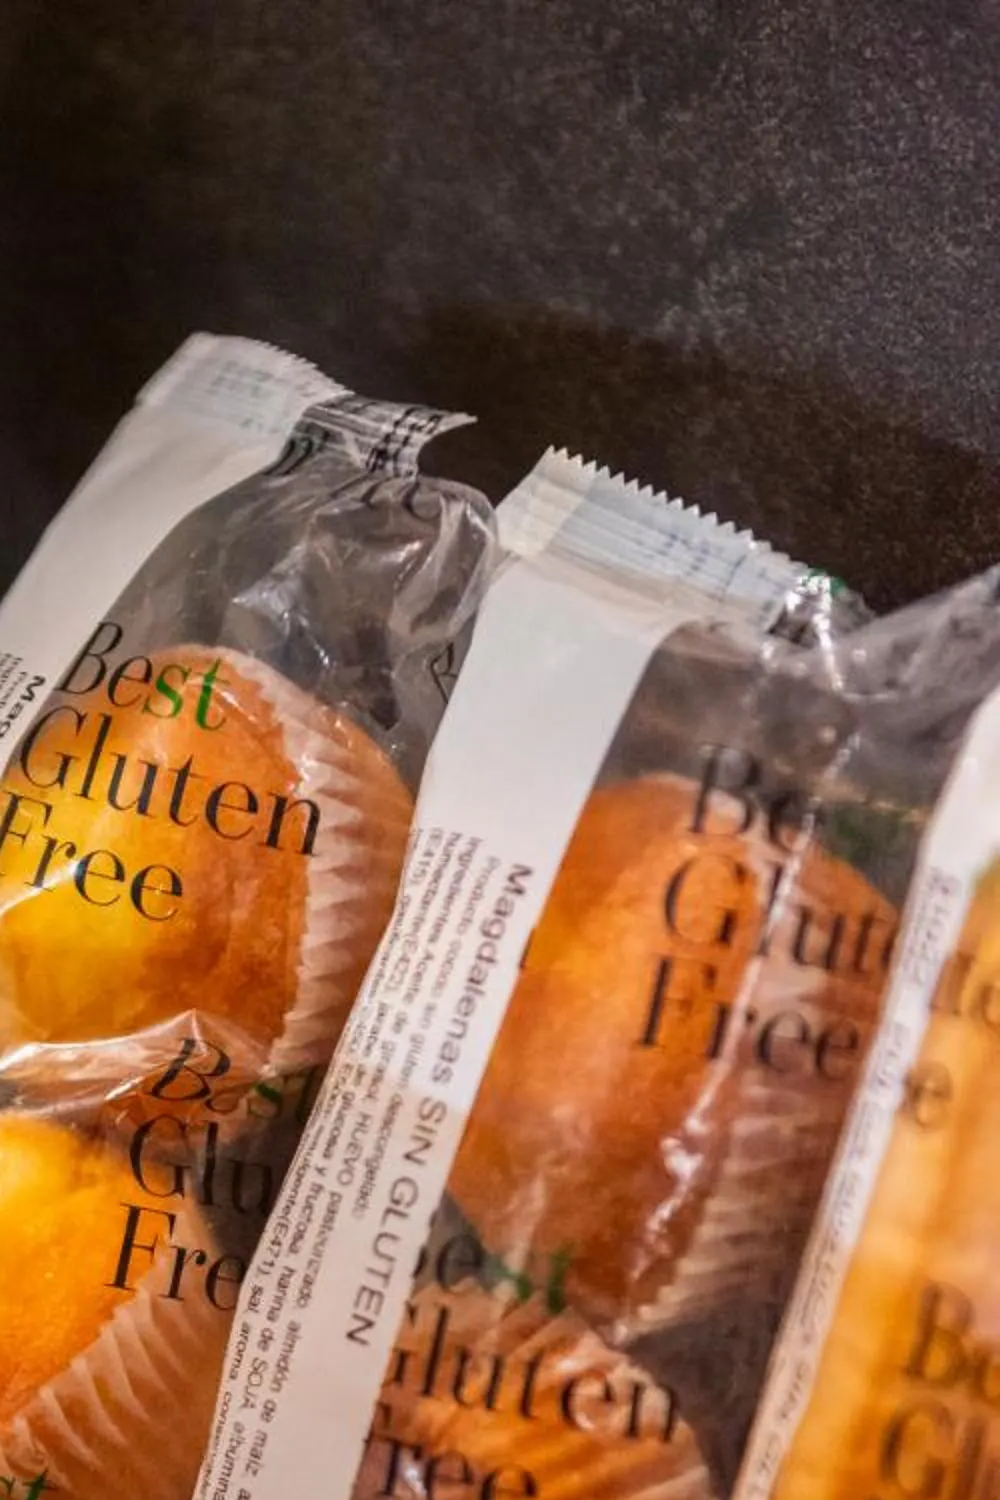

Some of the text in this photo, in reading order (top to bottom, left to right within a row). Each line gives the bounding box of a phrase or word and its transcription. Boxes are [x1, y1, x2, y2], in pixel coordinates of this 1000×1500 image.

[58, 622, 231, 731] Best
[19, 705, 321, 857] Gluten
[430, 860, 533, 1088] Magdalenas
[312, 1163, 328, 1177] y
[334, 1110, 373, 1187] HUEVO
[401, 1095, 447, 1167] SIN
[104, 1203, 248, 1311] Fre
[343, 1173, 421, 1346] GLUTEN
[256, 1326, 276, 1353] de
[259, 1398, 279, 1424] de
